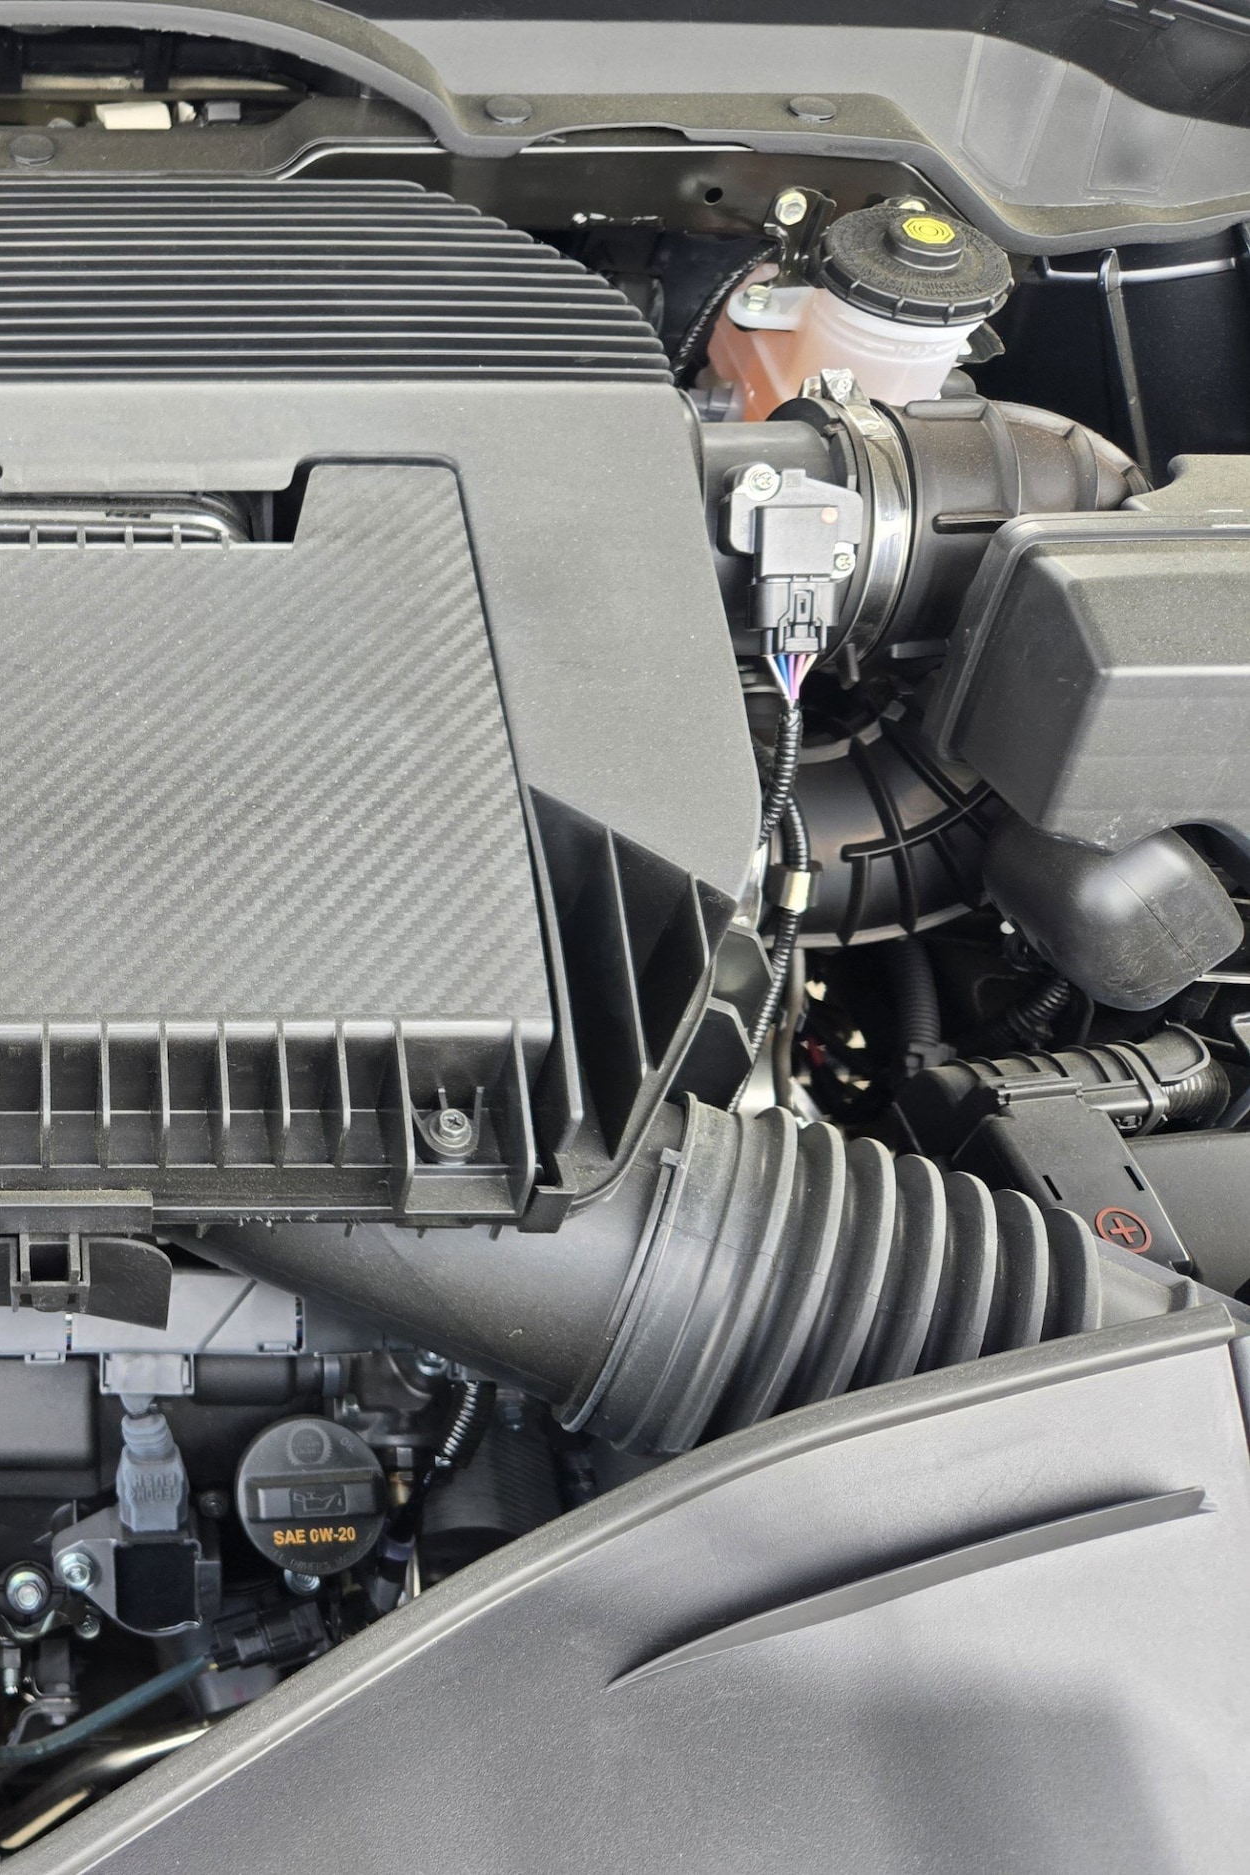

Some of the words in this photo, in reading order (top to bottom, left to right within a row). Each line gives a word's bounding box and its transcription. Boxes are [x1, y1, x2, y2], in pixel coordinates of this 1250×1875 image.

[895, 343, 936, 359] MAX
[133, 1472, 175, 1486] PUSH
[273, 1529, 307, 1546] SAE
[309, 1526, 356, 1543] 0W-20
